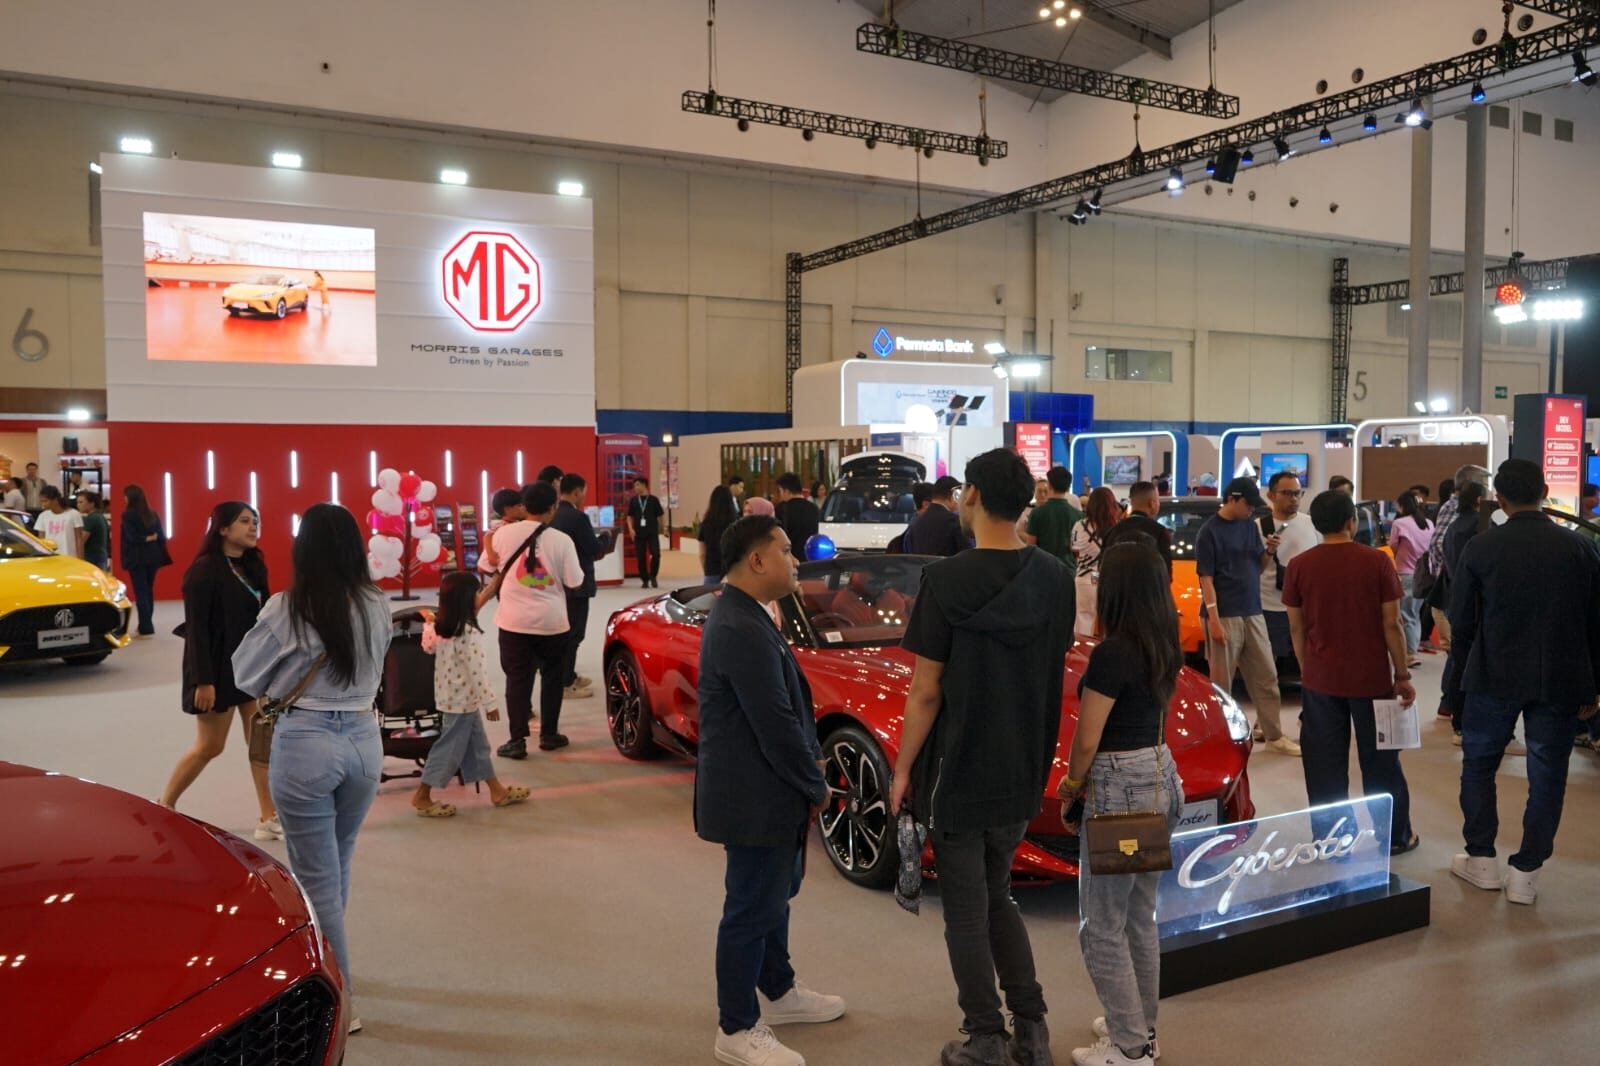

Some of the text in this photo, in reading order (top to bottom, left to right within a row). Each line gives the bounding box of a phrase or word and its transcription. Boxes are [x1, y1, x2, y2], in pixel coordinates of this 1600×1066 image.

[452, 241, 530, 321] MG
[12, 307, 50, 362] 6
[411, 344, 563, 357] MORRIS GARAGES
[896, 336, 975, 353] Permata Bank
[449, 355, 530, 367] Driven by Passion
[1352, 371, 1368, 401] 5
[55, 609, 74, 628] MG
[1179, 809, 1212, 826] rster
[1177, 816, 1375, 915] Cyberster
